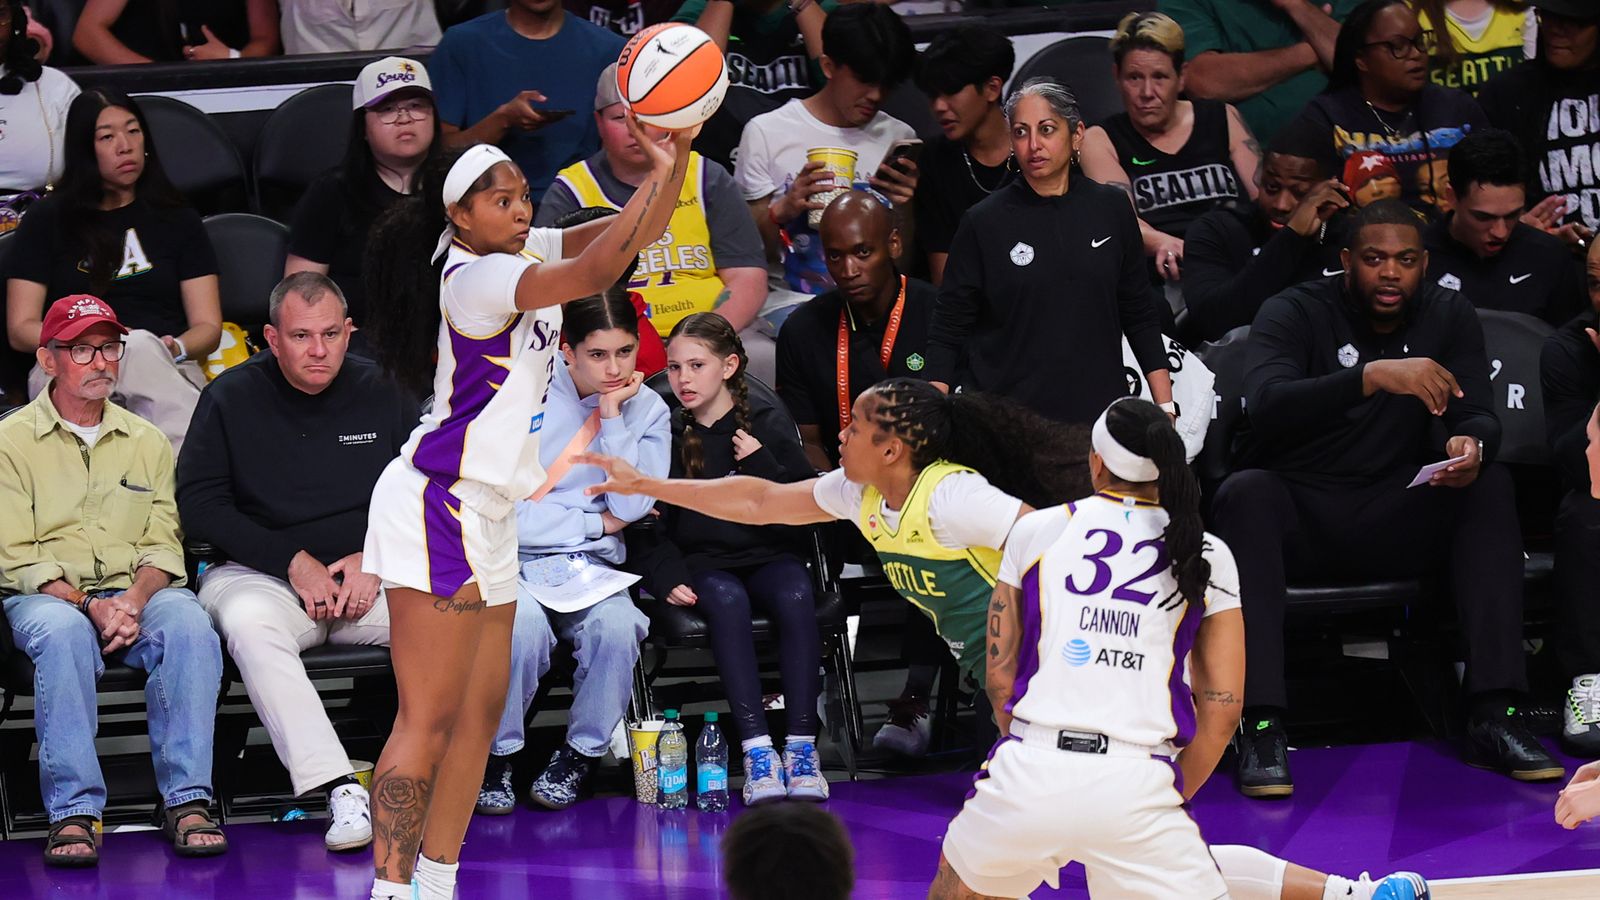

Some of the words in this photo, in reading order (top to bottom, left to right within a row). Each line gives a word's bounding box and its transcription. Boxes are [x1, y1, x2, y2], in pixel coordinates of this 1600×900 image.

[726, 52, 809, 94] SEATTL
[1430, 55, 1522, 88] SEATT
[1134, 164, 1239, 213] SEATTLE
[632, 244, 711, 276] GELES
[654, 299, 695, 315] Health
[882, 561, 946, 597] ATTLE
[1065, 528, 1172, 606] 32
[1079, 605, 1141, 638] CANNON
[1095, 648, 1146, 672] AT&T
